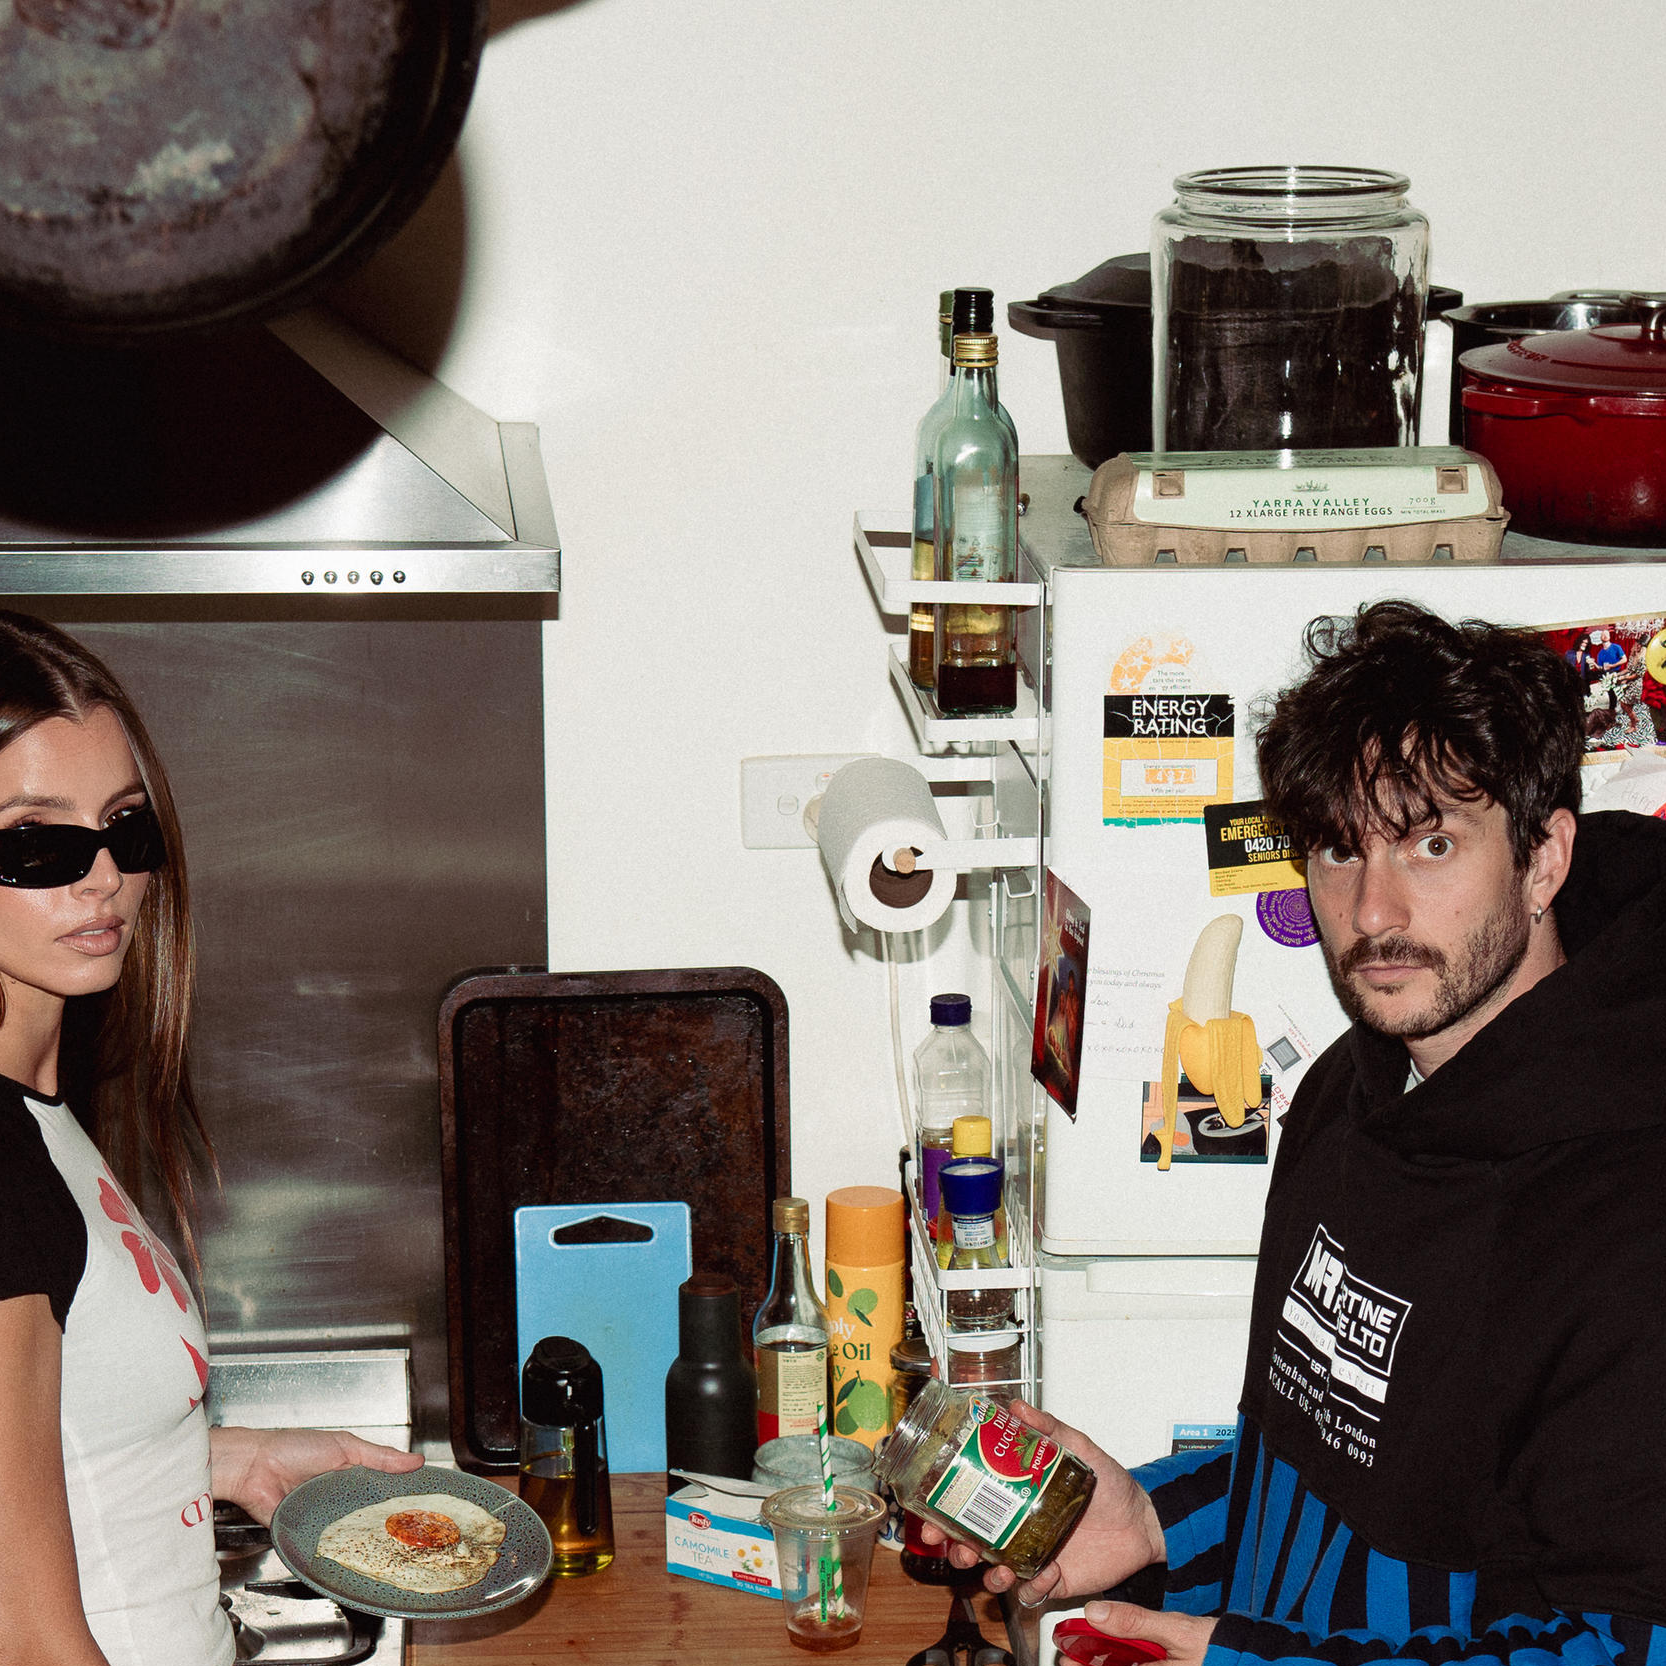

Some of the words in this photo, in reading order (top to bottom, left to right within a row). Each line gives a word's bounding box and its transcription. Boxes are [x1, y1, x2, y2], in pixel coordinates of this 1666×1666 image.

[1252, 498, 1303, 508] YARRA
[1312, 497, 1370, 508] VALLEY
[1229, 509, 1243, 519] 12
[1246, 508, 1290, 518] XLARGE
[1293, 508, 1320, 518] FREE
[1322, 507, 1362, 517] RANGE
[1364, 507, 1393, 516] EGGS
[1133, 700, 1207, 716] ENERGY
[1134, 718, 1207, 734] RATING
[1229, 818, 1244, 827] YOUR
[1244, 837, 1274, 853] 0420
[1247, 852, 1281, 863] SENIORS
[1091, 967, 1122, 977] blessings
[1123, 968, 1131, 977] of
[1131, 969, 1165, 978] Christmas
[1103, 979, 1123, 989] today
[842, 1342, 871, 1361] Oil
[1288, 1304, 1310, 1329] Your
[1338, 1364, 1376, 1395] expert
[1308, 1383, 1325, 1404] and
[1334, 1415, 1377, 1449] London
[1179, 1428, 1201, 1437] Area
[1203, 1428, 1209, 1437] 1
[1298, 1392, 1313, 1416] US:
[1347, 1442, 1375, 1468] 0993
[1031, 1441, 1047, 1471] POLSKI
[674, 1536, 730, 1559] CAMOMILE
[692, 1551, 714, 1566] TEA
